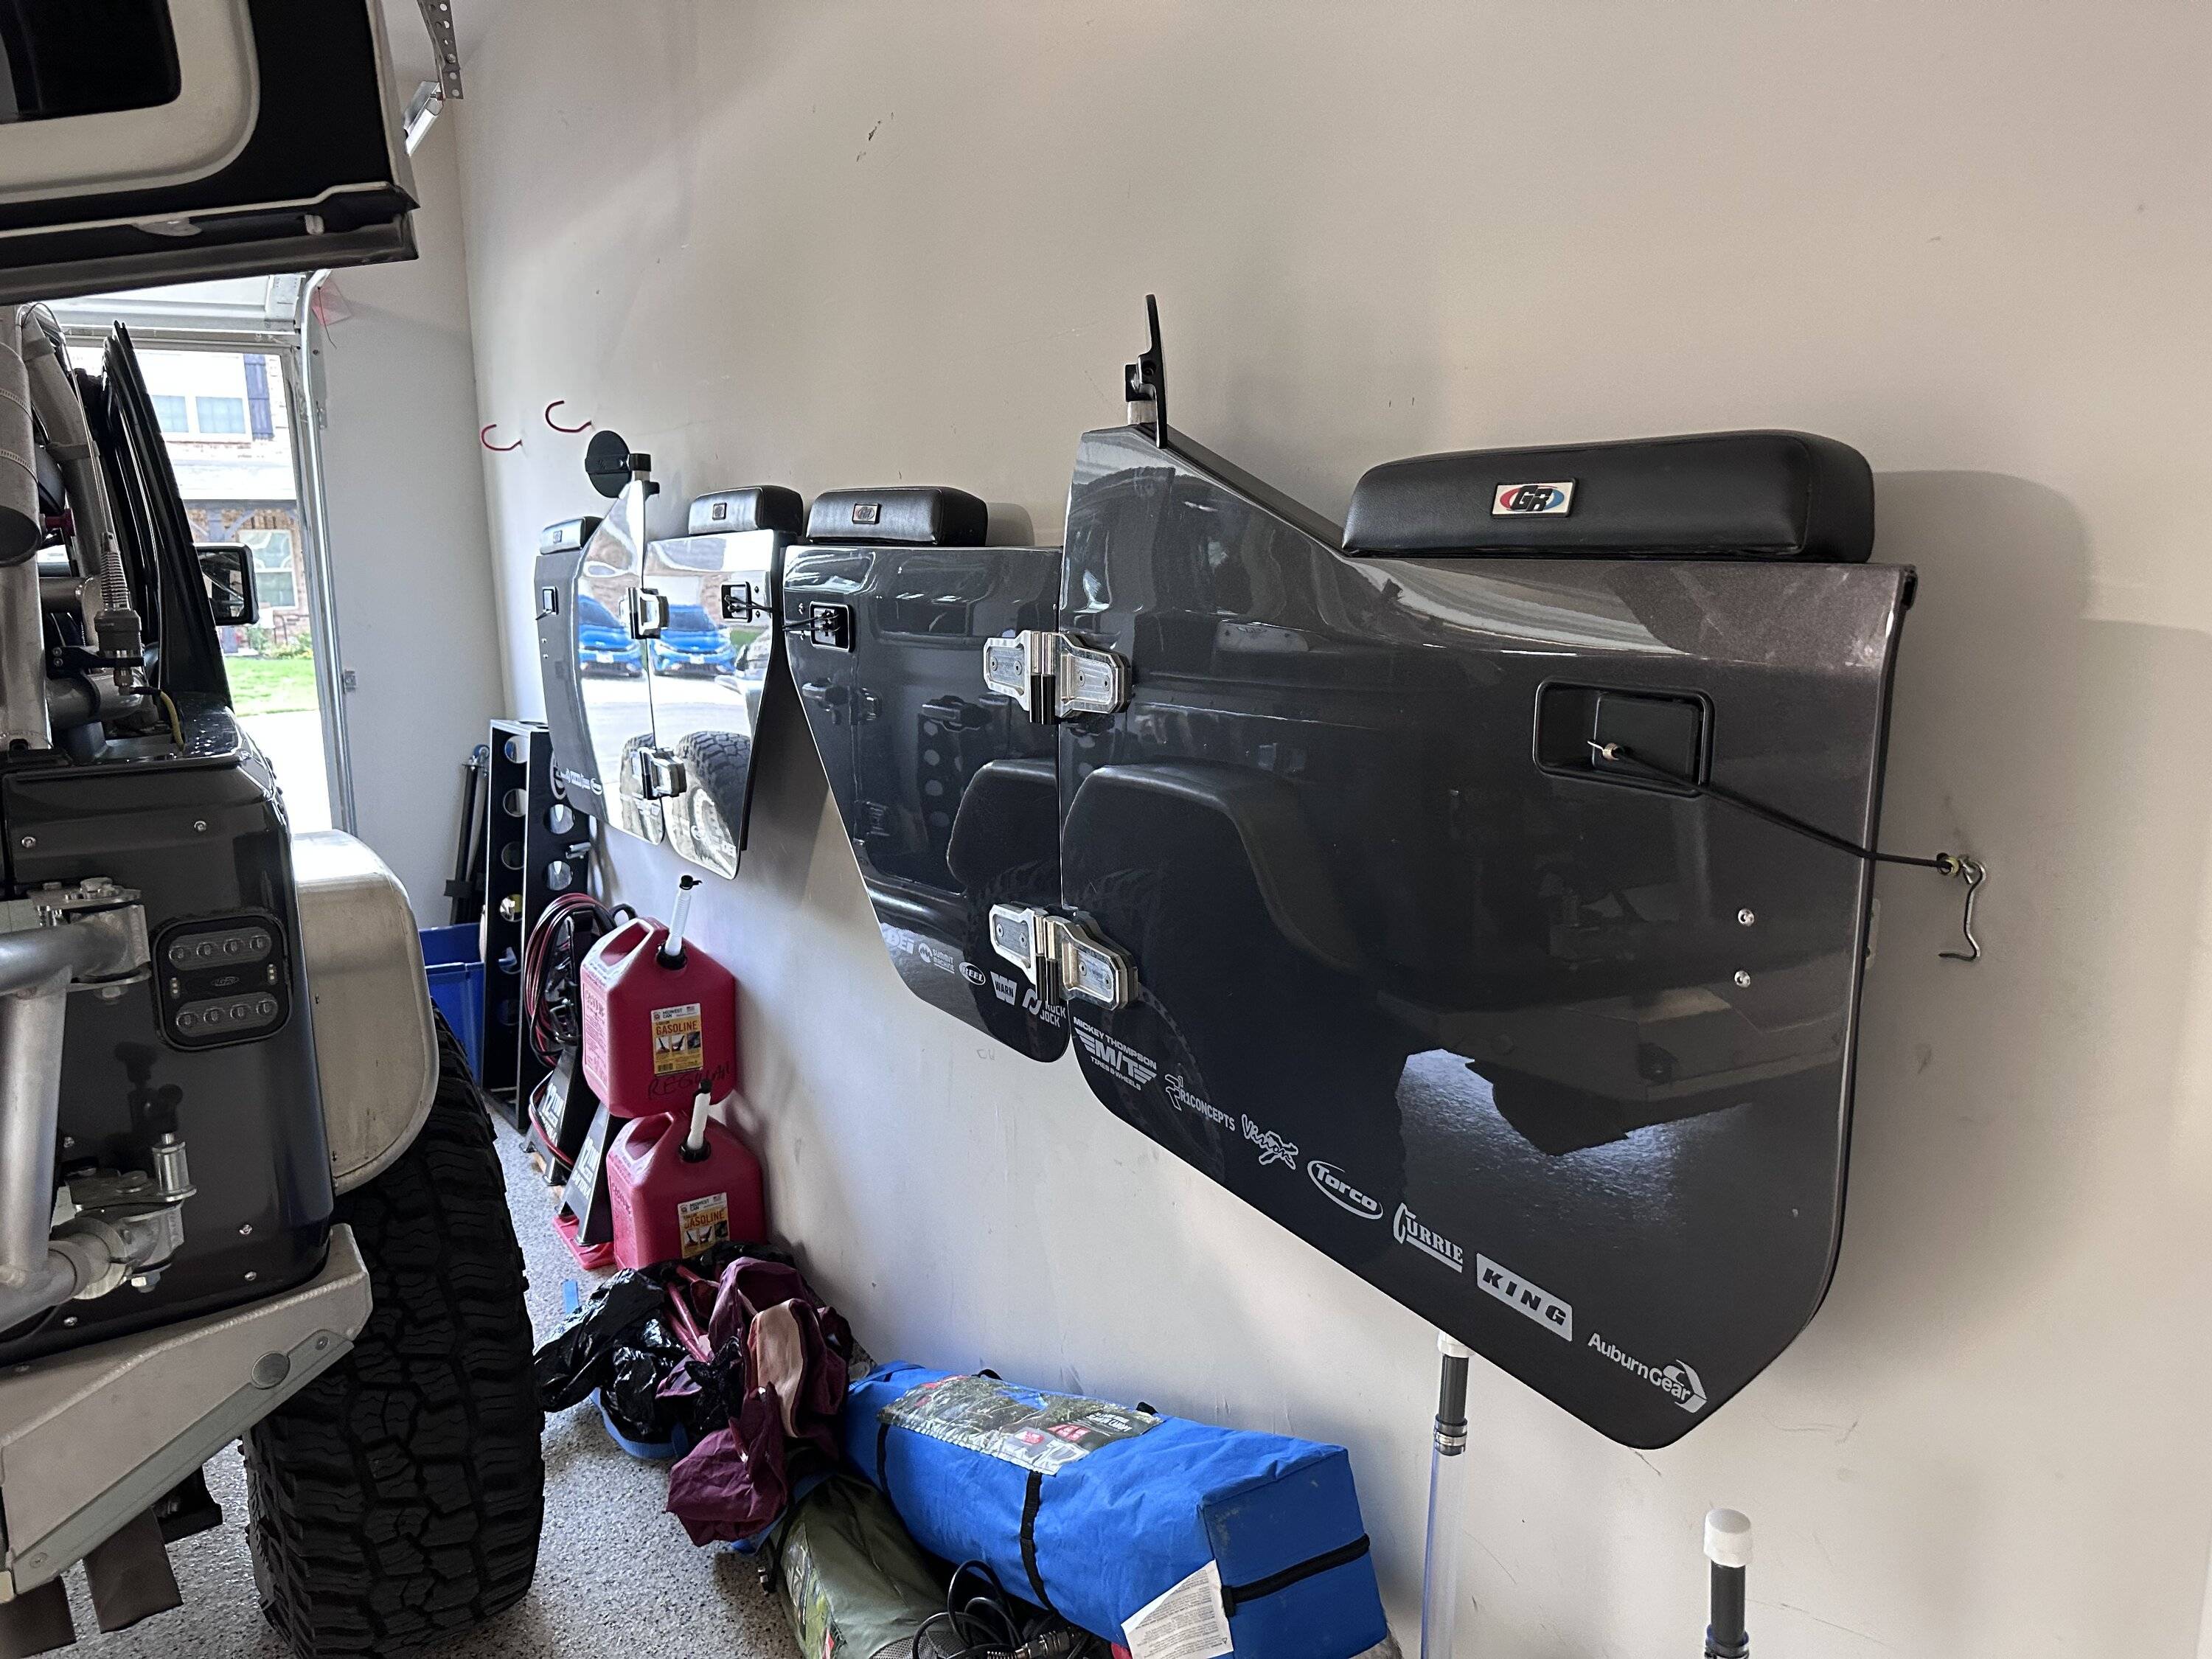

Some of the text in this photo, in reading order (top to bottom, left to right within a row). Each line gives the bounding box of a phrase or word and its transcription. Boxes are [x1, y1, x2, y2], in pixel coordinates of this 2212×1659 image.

[1510, 485, 1554, 512] GR
[961, 965, 984, 982] REEL
[995, 981, 1014, 998] WARN
[655, 1020, 698, 1036] GASOLINE
[1040, 1009, 1060, 1028] JOCK
[1073, 1016, 1157, 1071] MICKEY THOMPSON
[1095, 1039, 1138, 1077] M/T
[1115, 1071, 1141, 1091] WHEELS
[1315, 1164, 1377, 1211] Torco
[1394, 1202, 1463, 1265] CURRIE
[1483, 1267, 1566, 1326] KING
